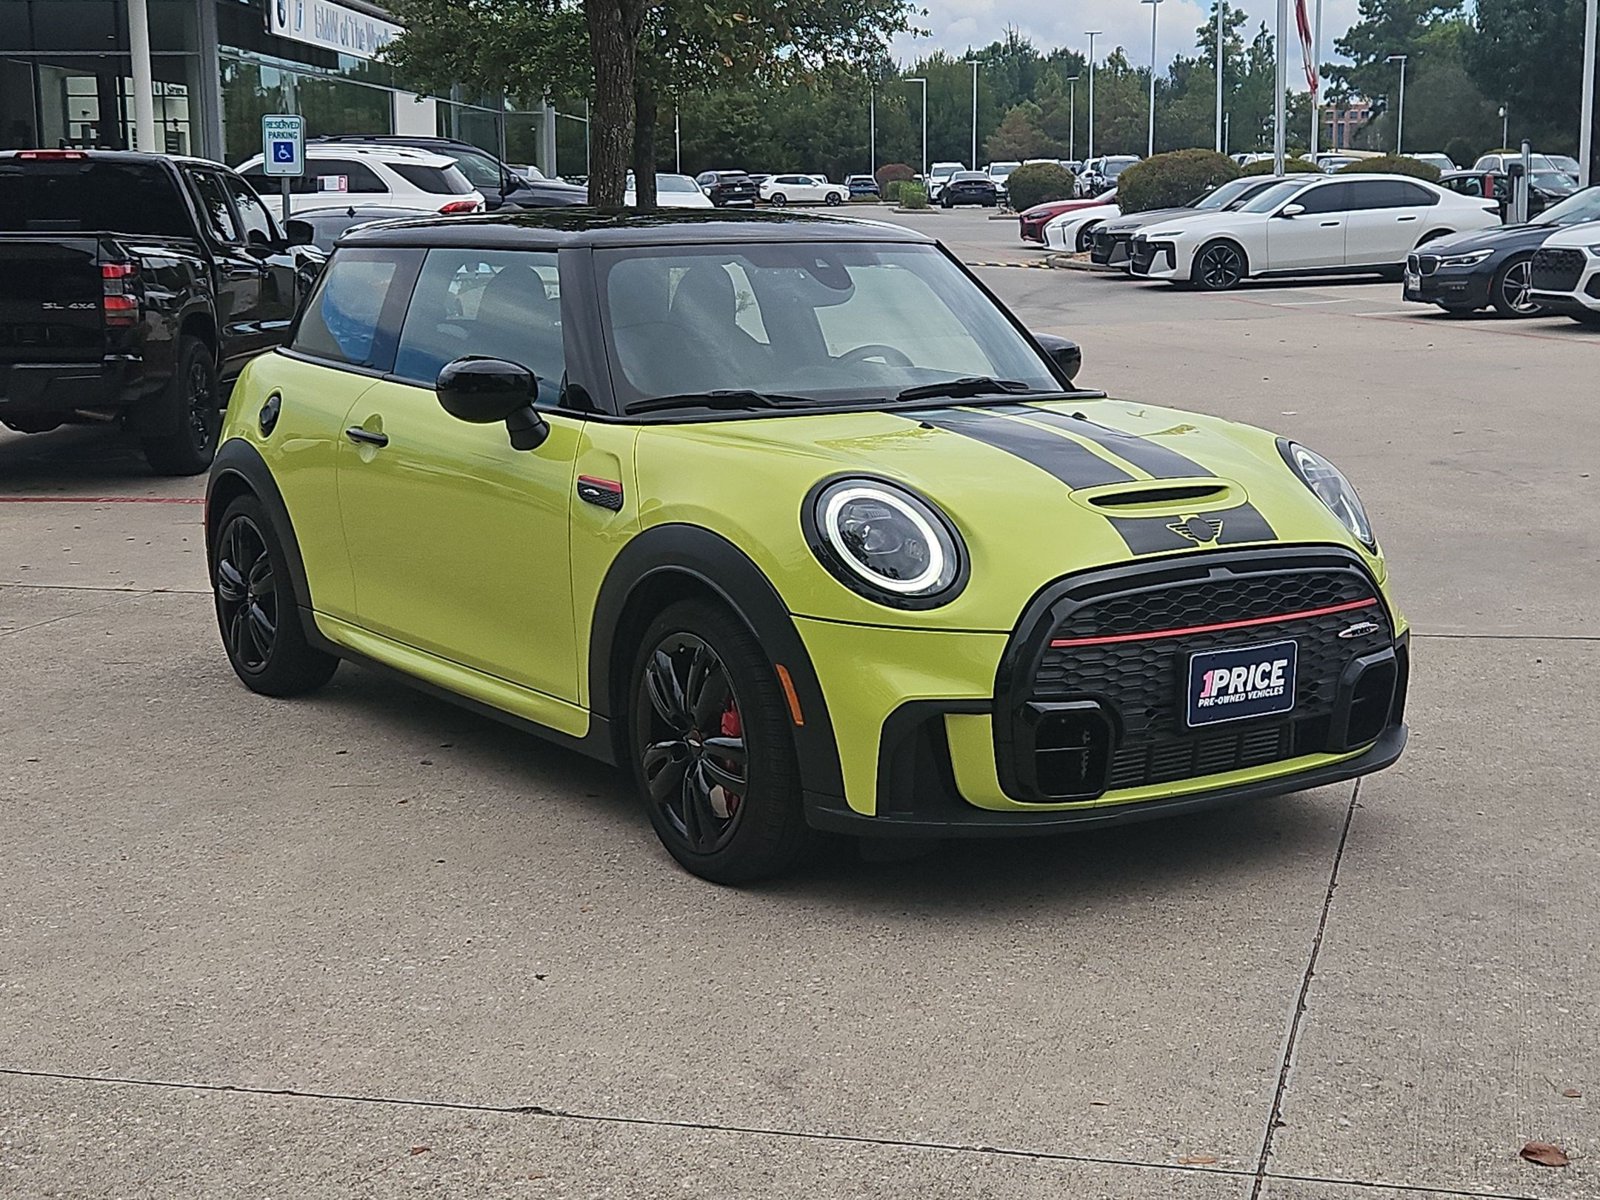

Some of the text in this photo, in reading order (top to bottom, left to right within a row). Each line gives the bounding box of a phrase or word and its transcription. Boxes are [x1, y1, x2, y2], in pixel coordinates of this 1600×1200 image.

[314, 4, 339, 43] BMW
[340, 15, 349, 47] of
[349, 16, 365, 51] The
[265, 120, 300, 129] RESERVED
[267, 131, 298, 139] PARKING
[1197, 686, 1285, 708] PRE-OWNED VEHICLES
